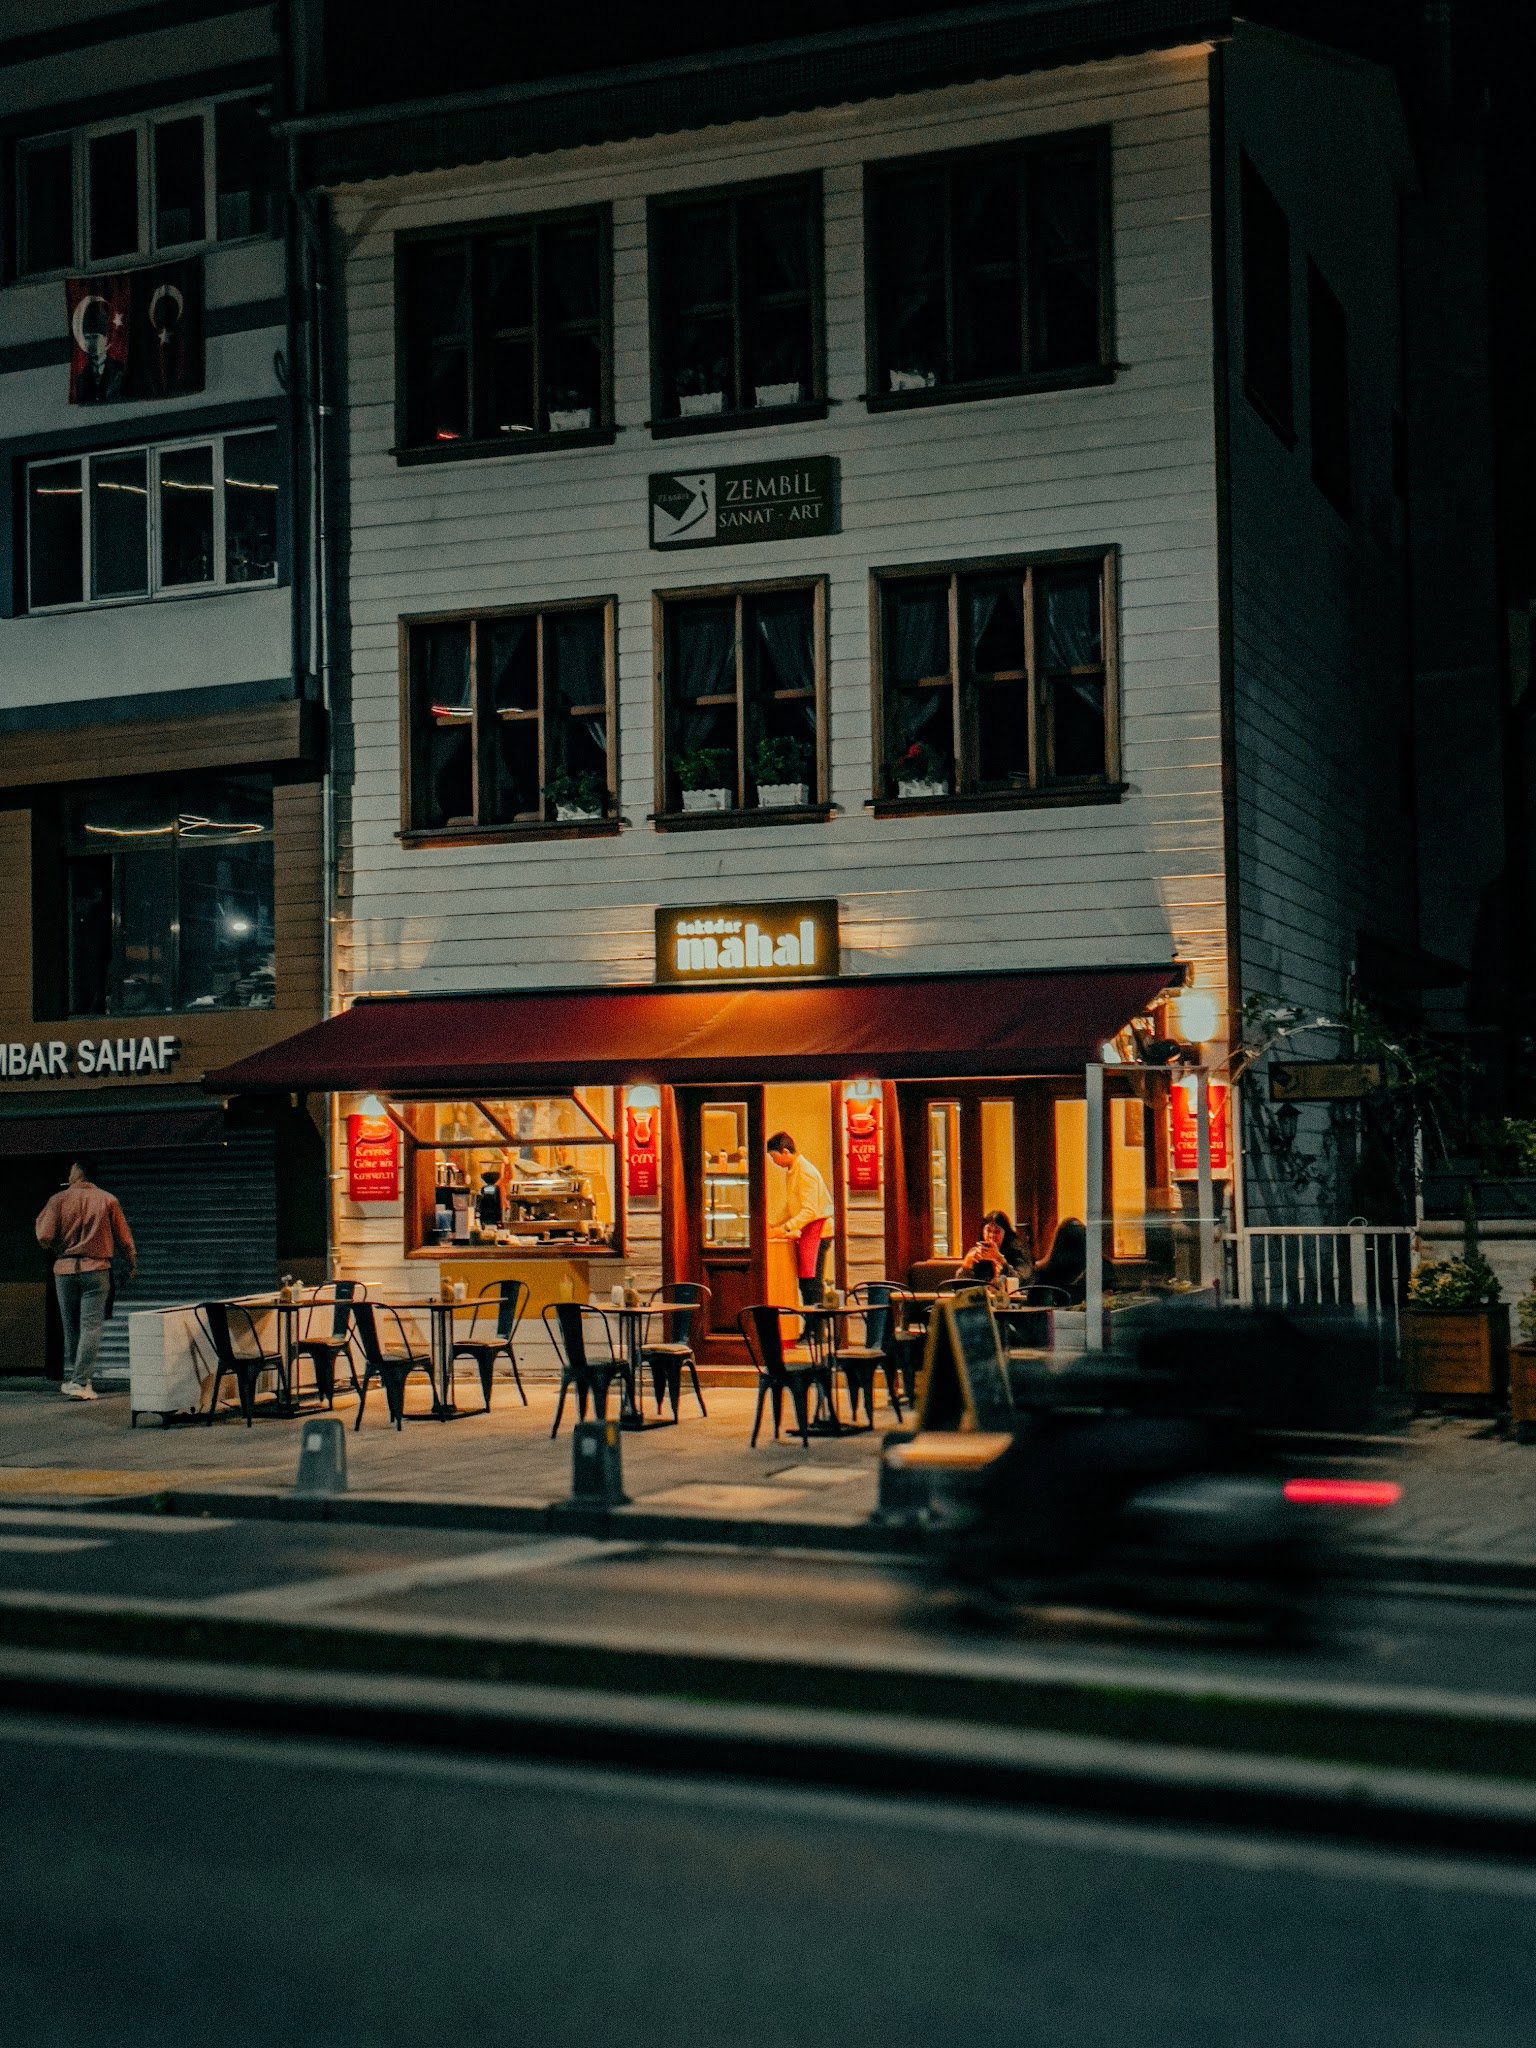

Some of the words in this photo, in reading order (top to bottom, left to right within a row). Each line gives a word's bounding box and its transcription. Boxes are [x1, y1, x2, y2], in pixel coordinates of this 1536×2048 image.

[726, 469, 816, 502] ZEMBİL
[719, 507, 775, 528] SANAT
[789, 503, 823, 521] ART
[676, 920, 816, 971] mahal
[77, 1036, 175, 1073] SAHAF
